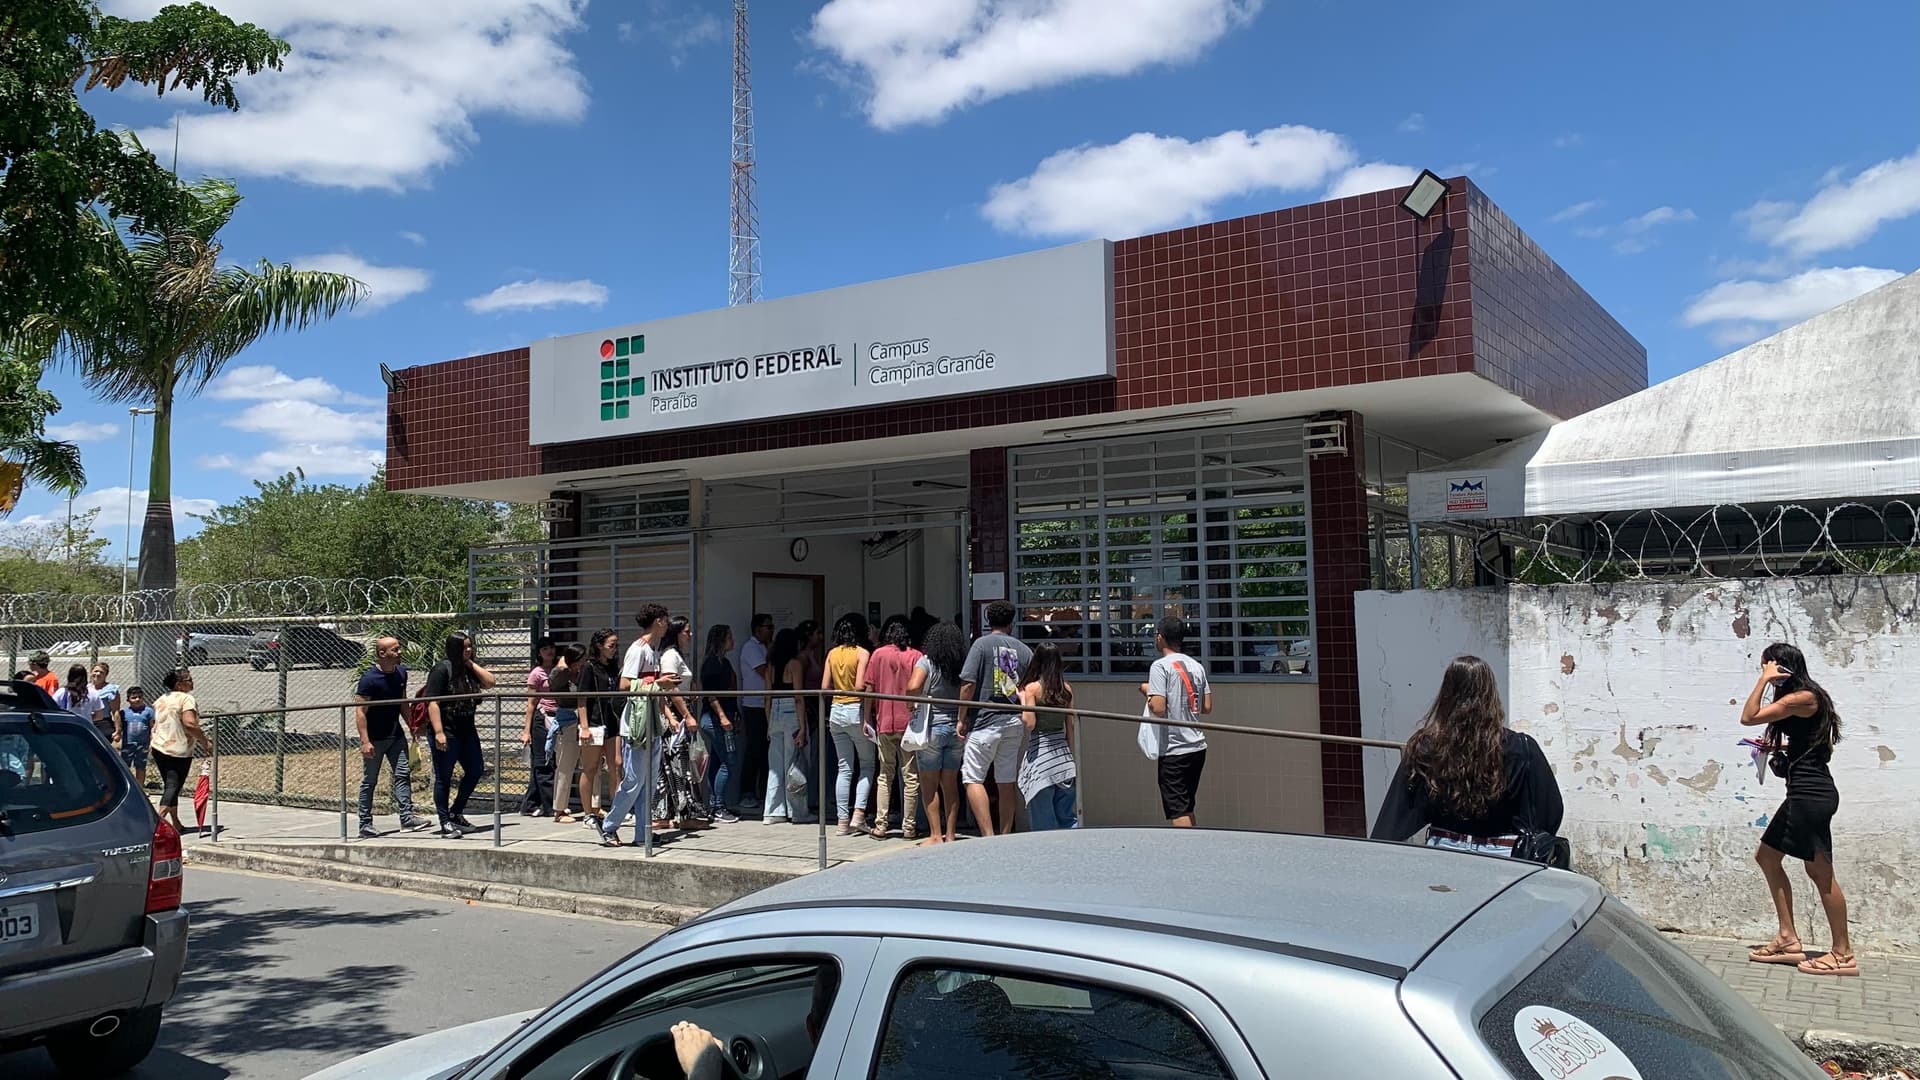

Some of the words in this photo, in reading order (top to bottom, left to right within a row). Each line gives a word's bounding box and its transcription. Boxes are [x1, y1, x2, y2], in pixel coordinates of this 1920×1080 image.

[869, 340, 930, 360] Campus
[652, 360, 749, 391] INSTITUTO
[755, 346, 842, 377] FEDERAL
[869, 362, 934, 384] Campina
[937, 352, 994, 374] Grande
[652, 393, 698, 412] Paraíba
[0, 916, 32, 939] 03
[1530, 1021, 1607, 1079] JESUS
